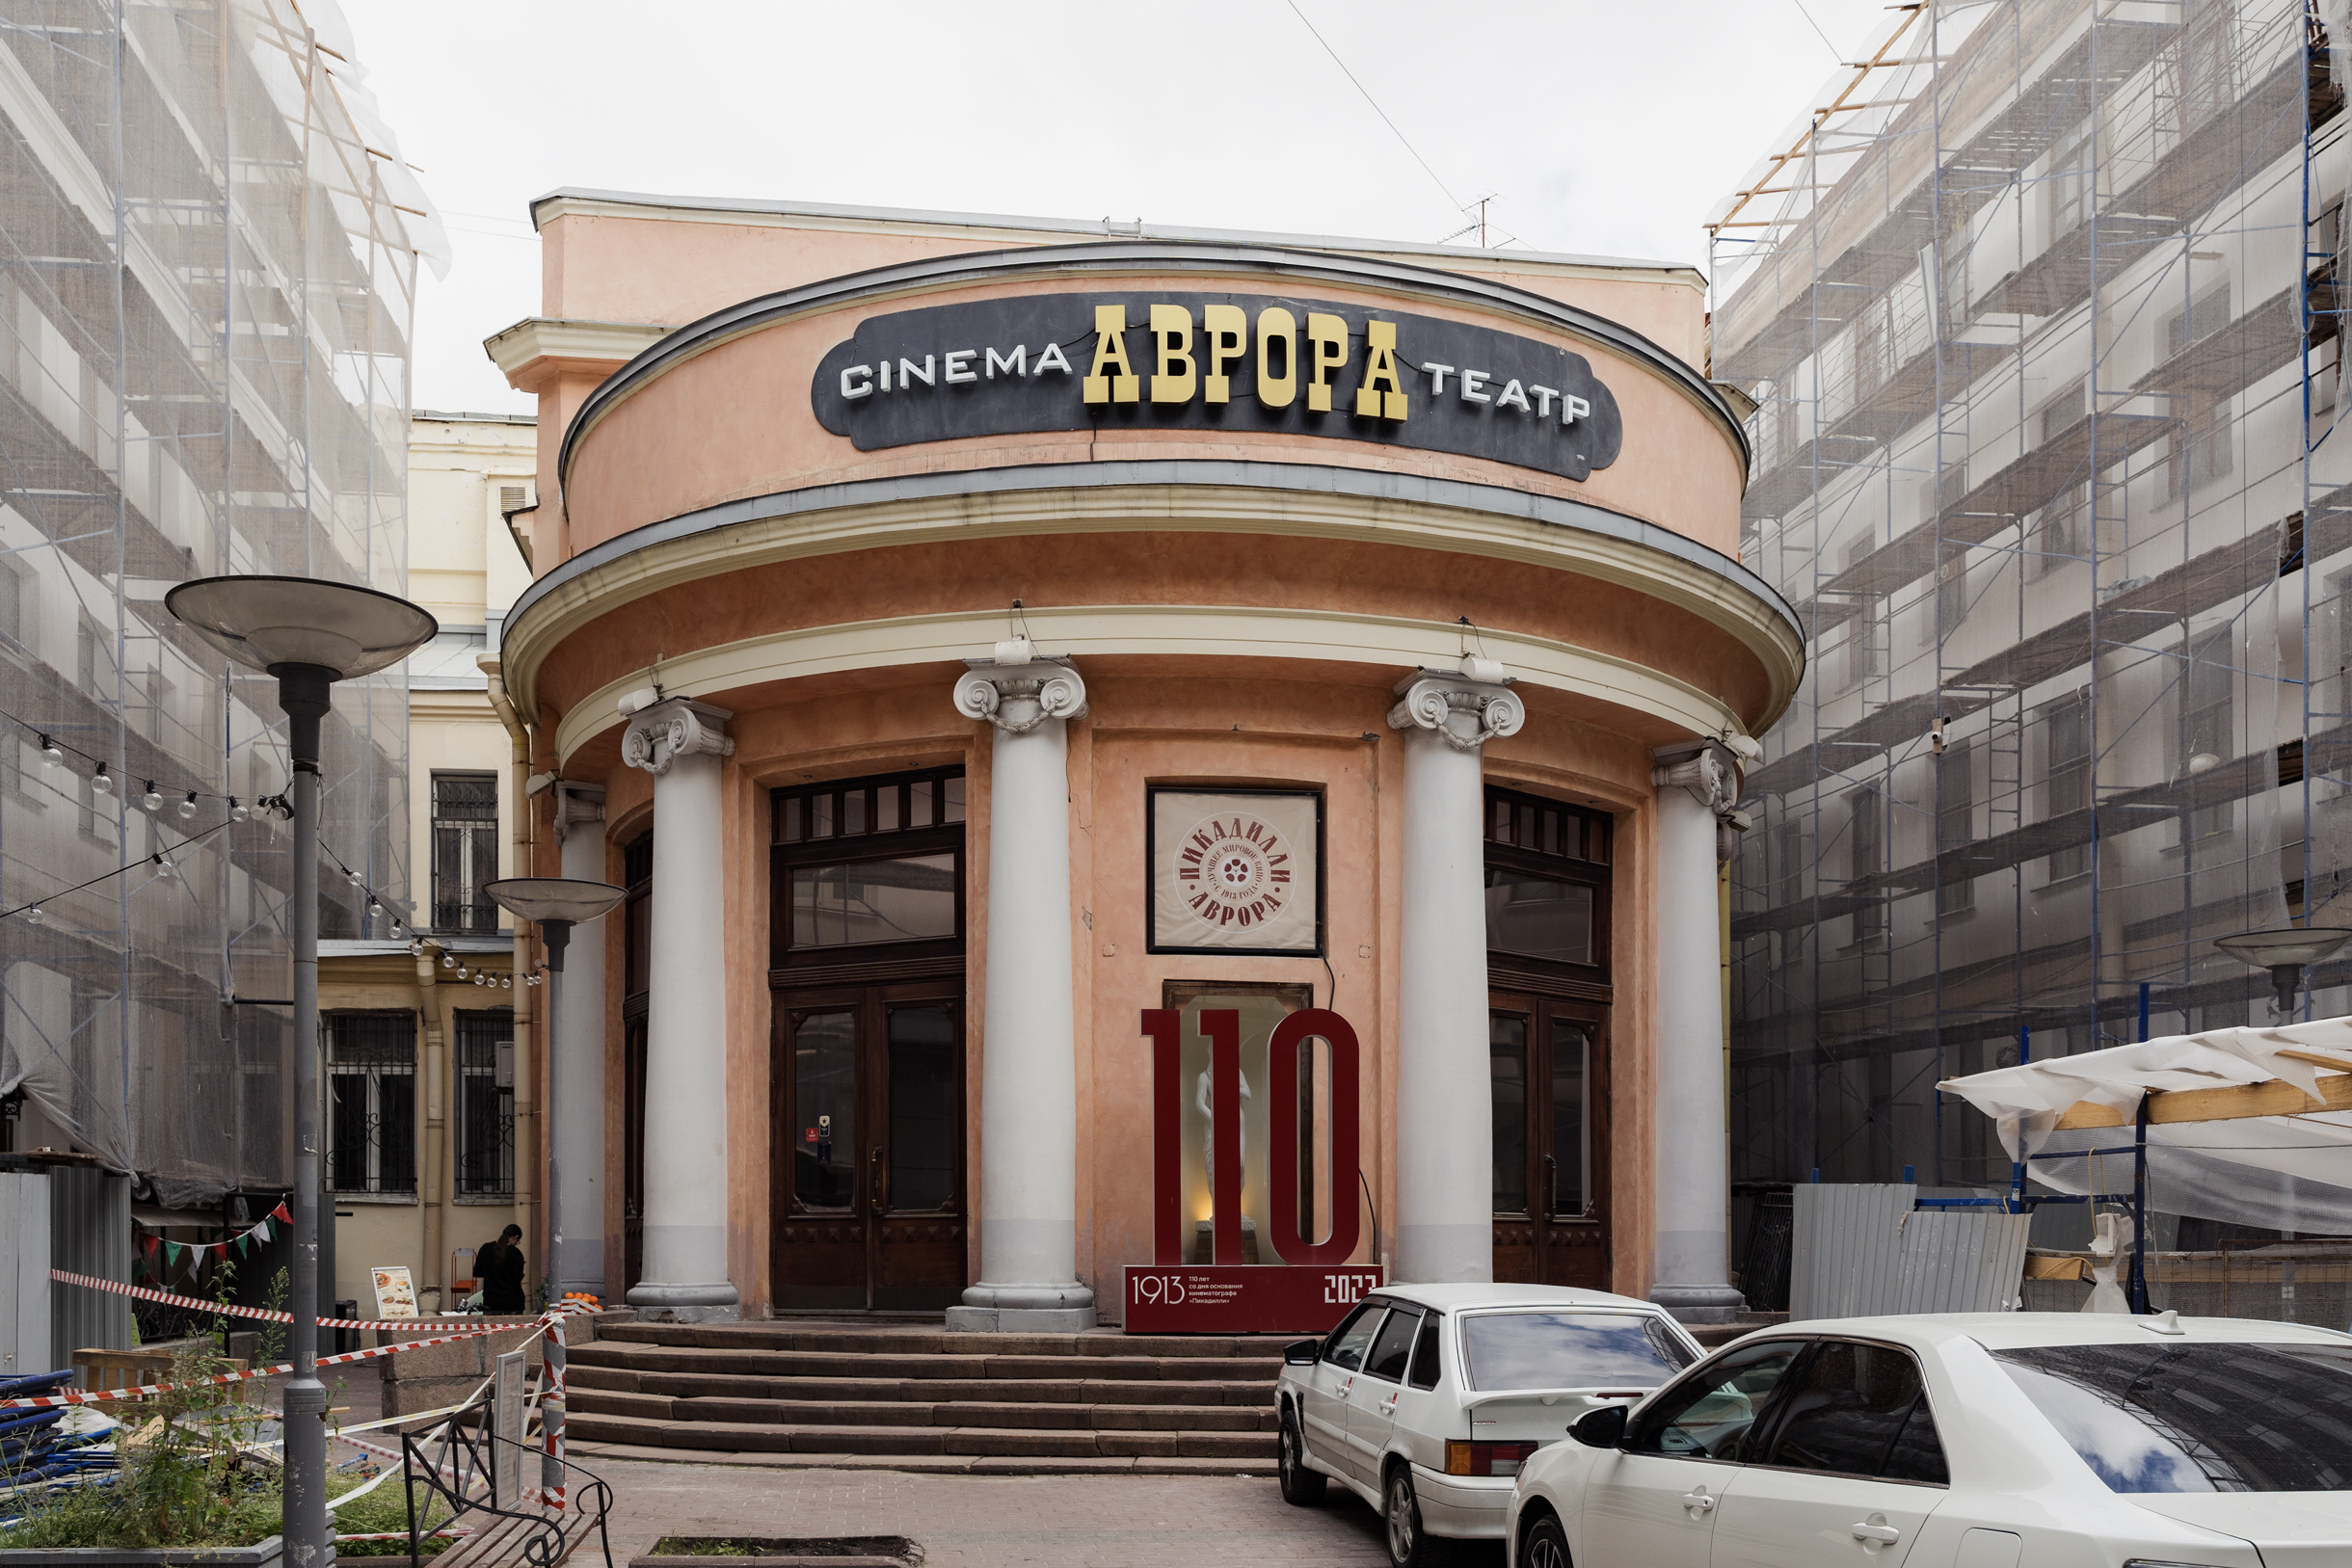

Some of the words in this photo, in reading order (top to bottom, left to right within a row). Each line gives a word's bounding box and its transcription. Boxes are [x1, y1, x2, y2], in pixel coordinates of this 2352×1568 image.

[841, 342, 1073, 400] CINEMA
[1082, 304, 1408, 424] АВРОРА
[1421, 361, 1590, 425] ТЕАТР
[1179, 817, 1291, 884] ПИКАДИЛЛИ
[1207, 849, 1223, 883] ЛУЧШЕЕ
[1221, 844, 1258, 862] МИРОВОЕ
[1253, 860, 1264, 883] КИНО
[1188, 890, 1283, 927] АВРОРА
[1220, 889, 1237, 900] 1913
[1239, 885, 1259, 900] ГОДА
[1139, 1008, 1360, 1265] 110
[1132, 1275, 1186, 1305] 1913
